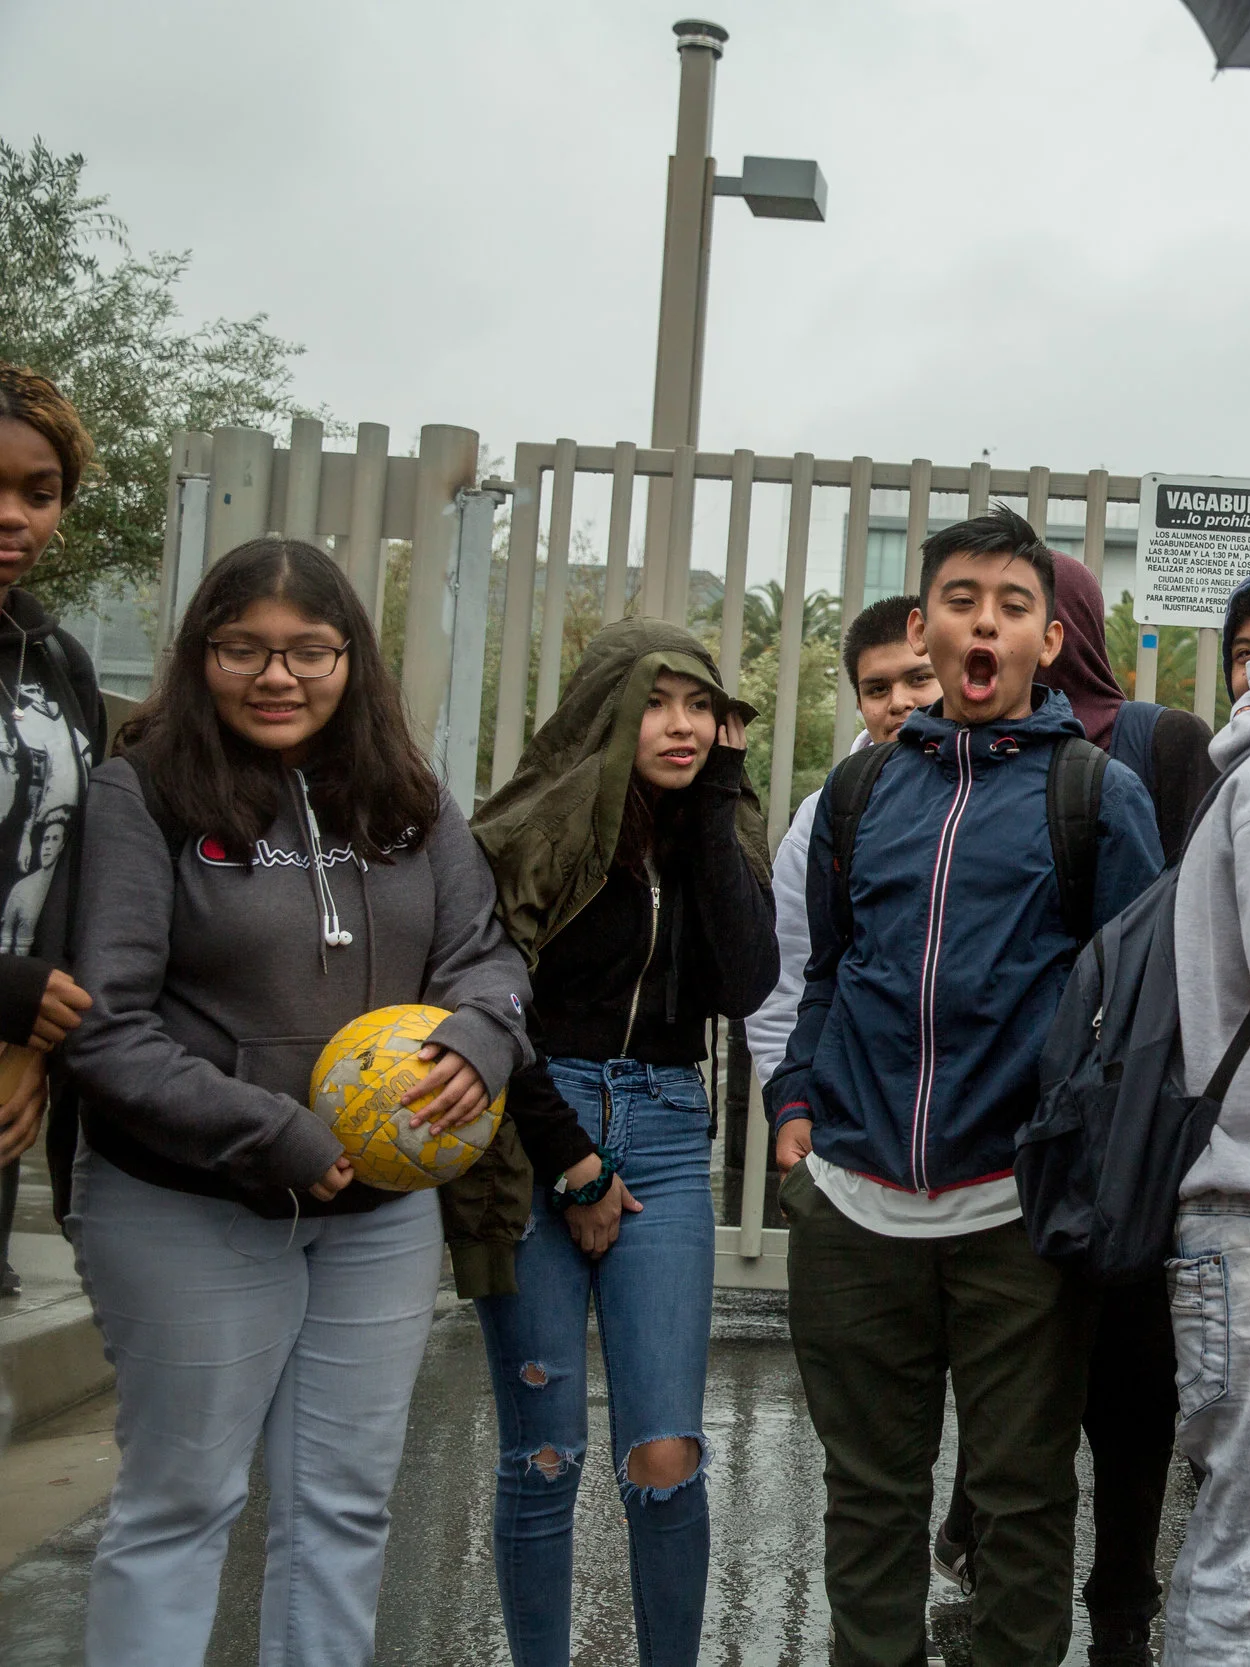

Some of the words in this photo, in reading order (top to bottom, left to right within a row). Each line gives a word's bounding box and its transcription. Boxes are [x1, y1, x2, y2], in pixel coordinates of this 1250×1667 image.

[1209, 534, 1246, 543] MENORES
[1150, 539, 1215, 549] VAGABUNDEANDO
[1190, 559, 1228, 567] ASCIENDE
[1153, 584, 1199, 593] REGLAMENTO
[1162, 604, 1214, 614] INJUSTIFICADAS,
